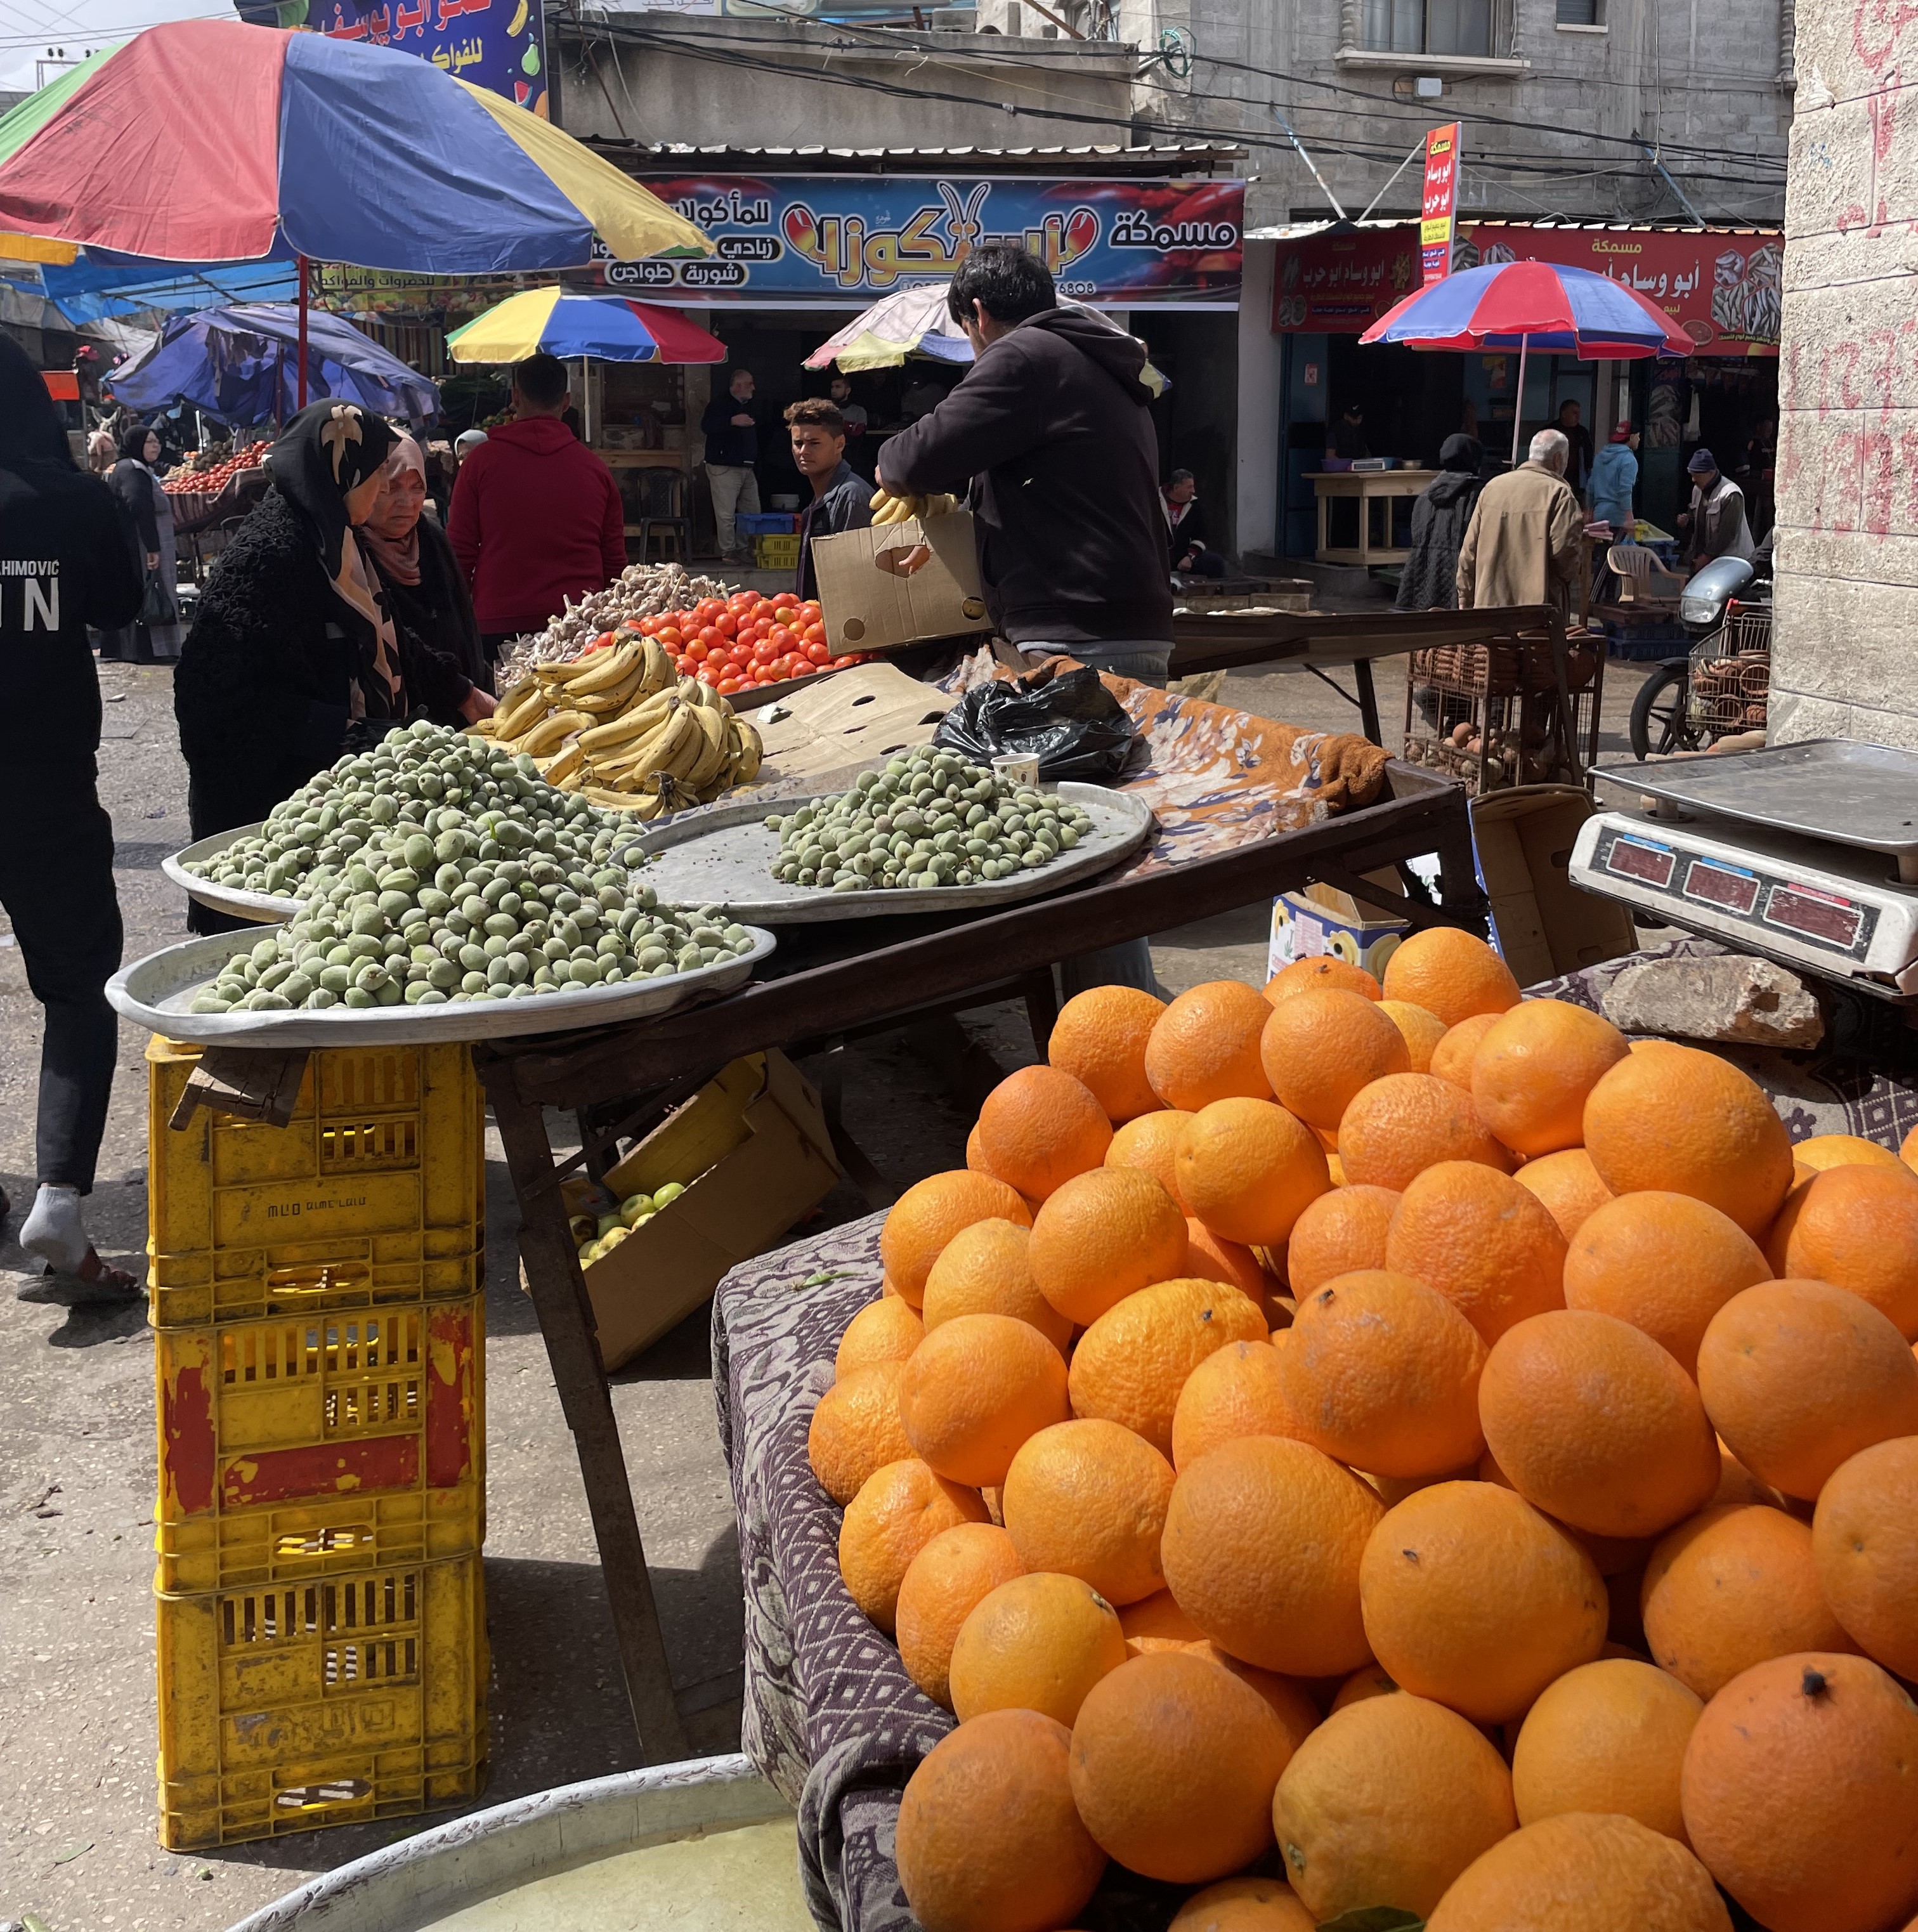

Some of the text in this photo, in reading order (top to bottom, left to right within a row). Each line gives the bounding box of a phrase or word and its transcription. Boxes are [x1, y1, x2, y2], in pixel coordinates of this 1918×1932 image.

[1430, 140, 1451, 155] مسمكة
[670, 190, 769, 229] للمأكولا
[1109, 211, 1236, 250] مسمكة
[720, 238, 774, 260] زبادي
[1591, 238, 1643, 254] مسمكة
[611, 263, 739, 284] شوربة طواجن
[1669, 259, 1700, 299] أبو
[0, 559, 60, 576] HIMOVIĆ
